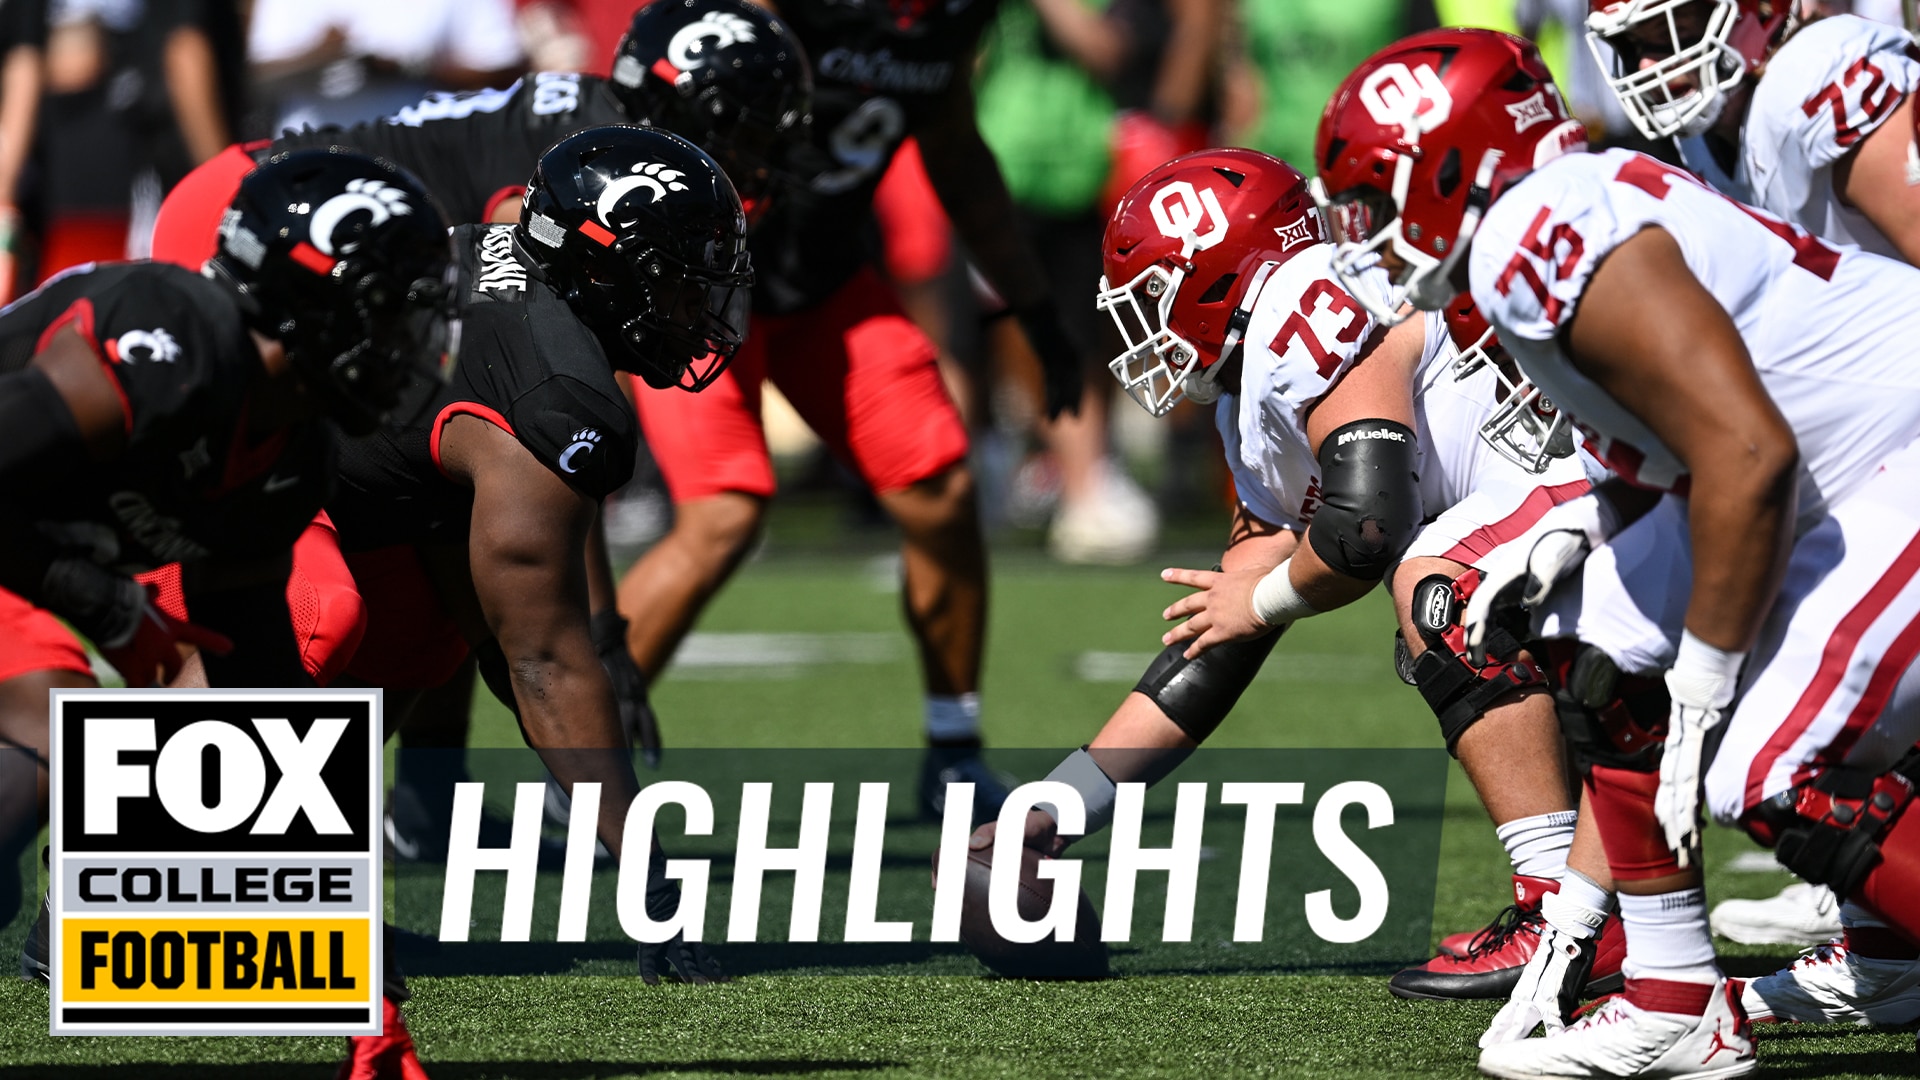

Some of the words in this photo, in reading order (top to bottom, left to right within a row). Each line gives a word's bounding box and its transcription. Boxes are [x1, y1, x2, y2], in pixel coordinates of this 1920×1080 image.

[1801, 56, 1903, 148] 72
[1149, 180, 1230, 251] OU
[1494, 204, 1585, 327] 75
[1268, 278, 1369, 381] 73
